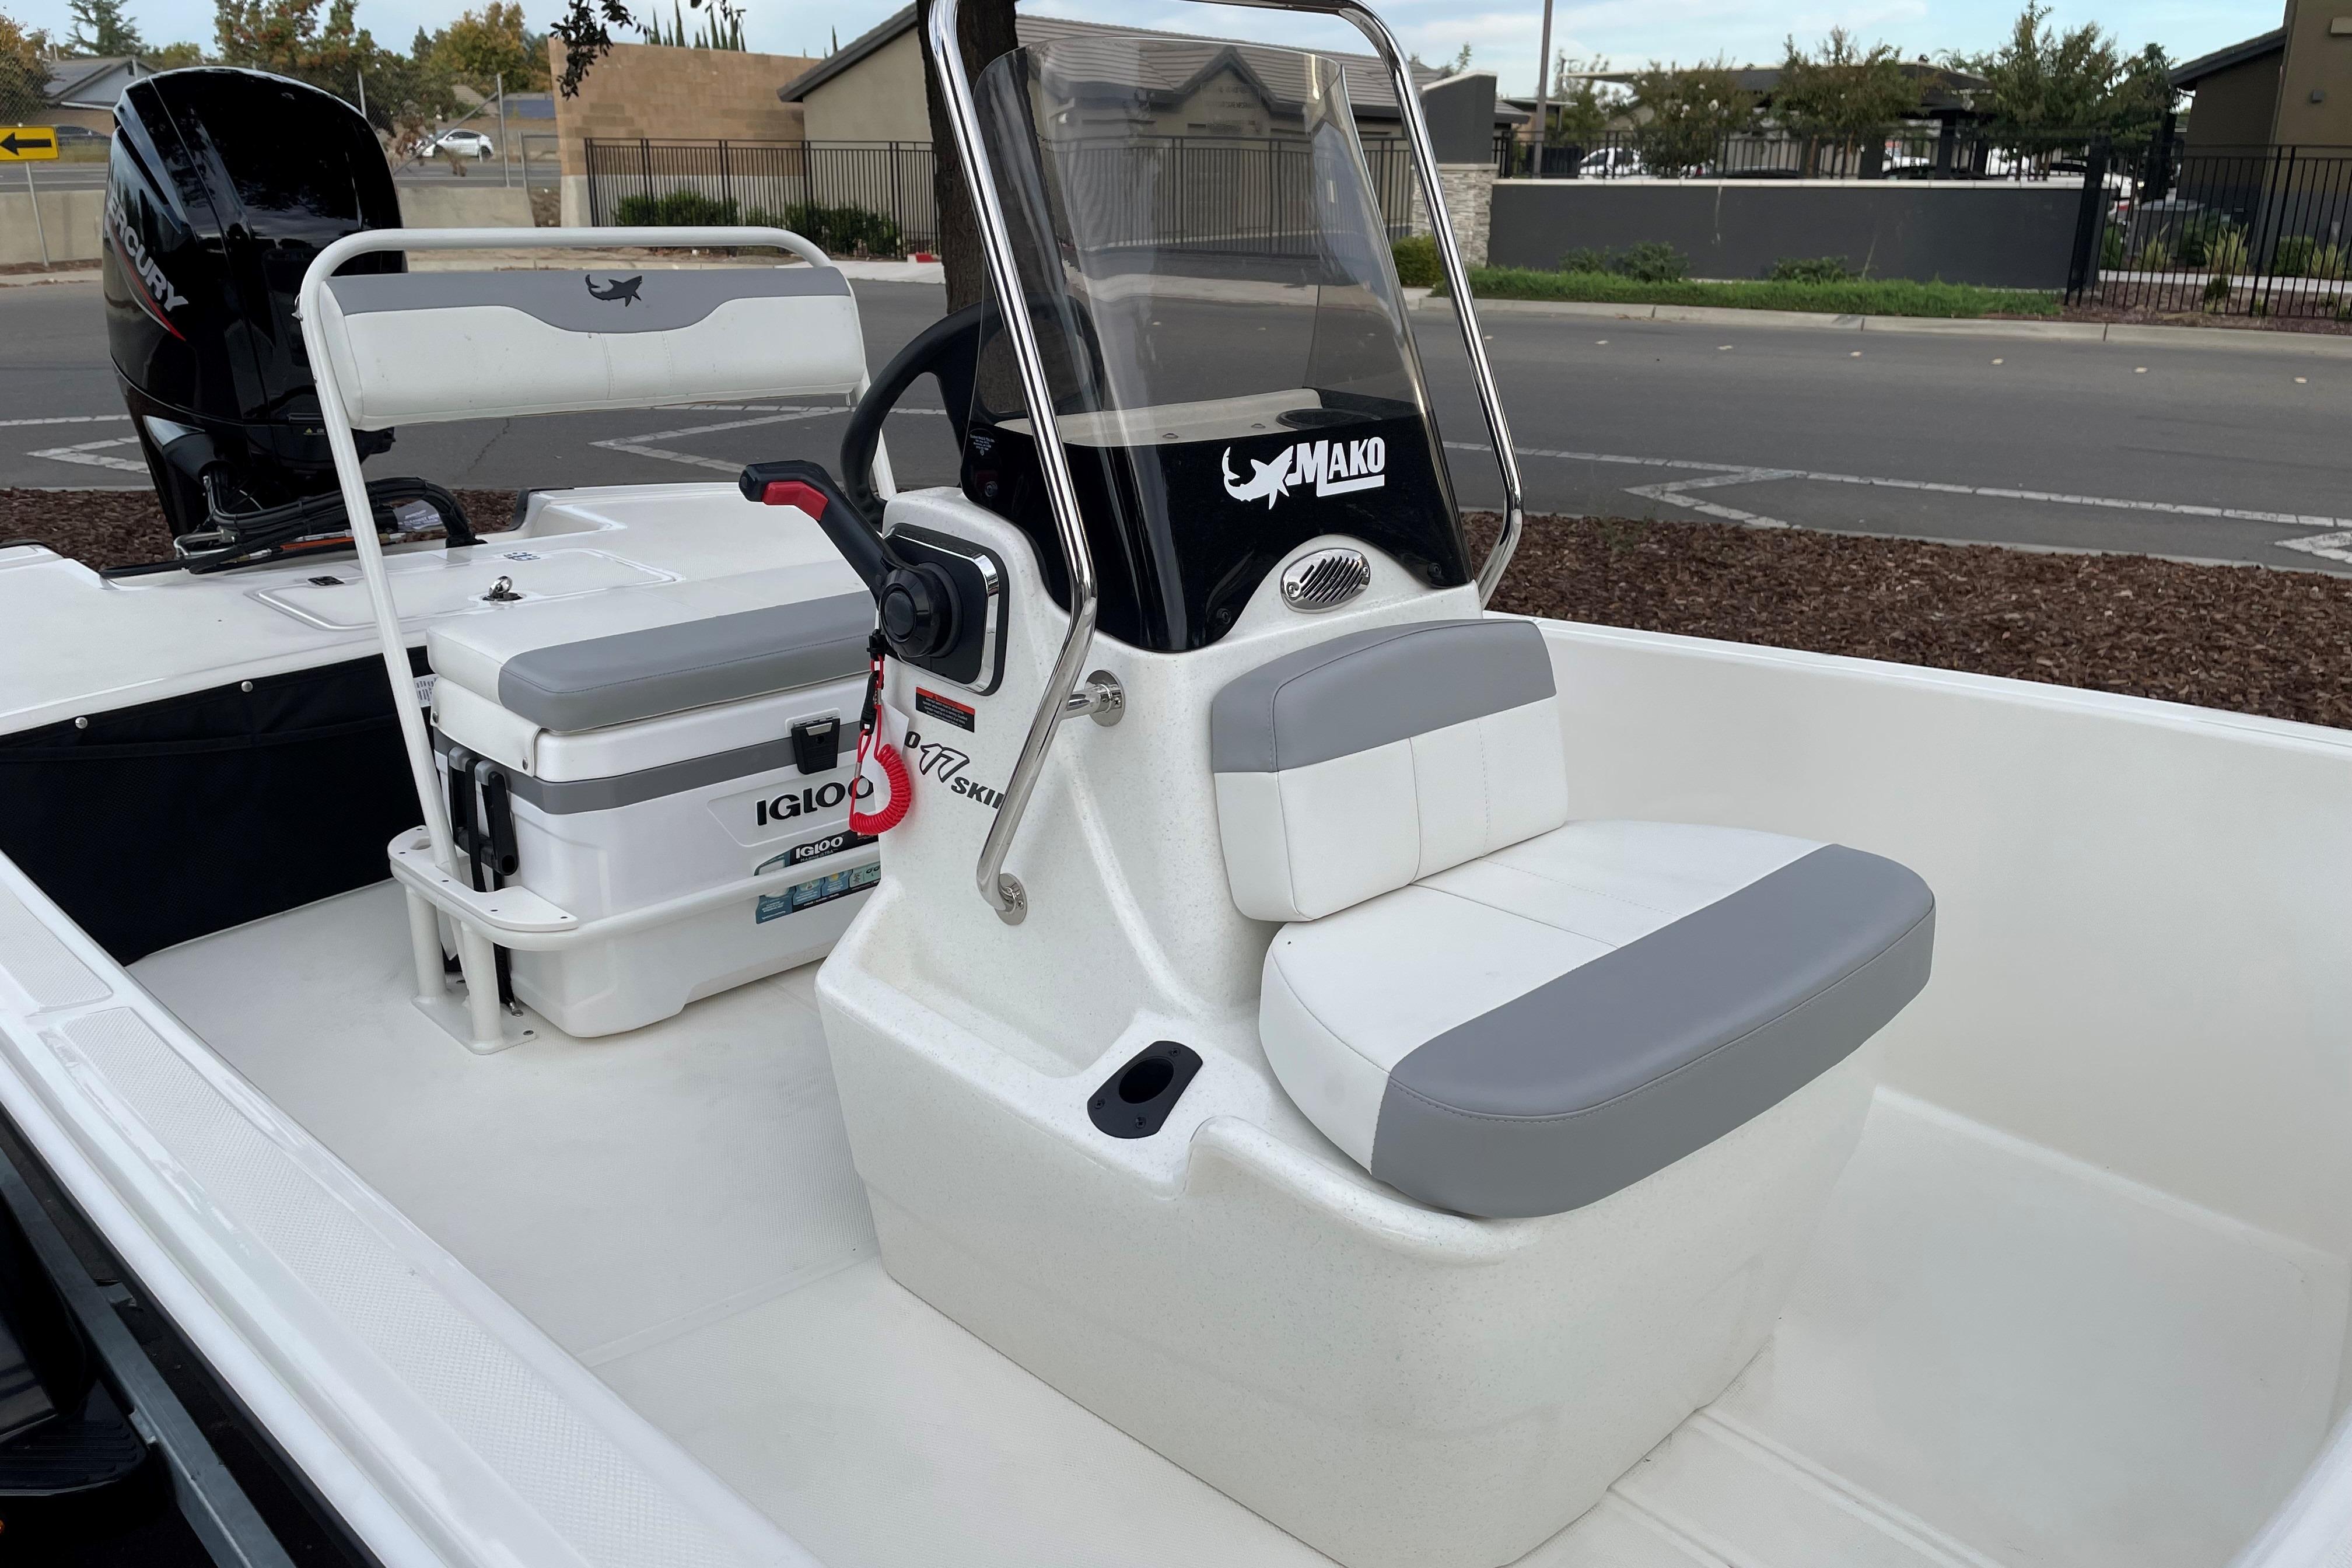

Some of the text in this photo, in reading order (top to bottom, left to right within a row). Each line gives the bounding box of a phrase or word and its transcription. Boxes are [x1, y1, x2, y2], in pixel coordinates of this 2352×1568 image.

[107, 190, 188, 312] ERCURY
[1284, 436, 1385, 497] MAKO
[919, 743, 971, 783] 17
[757, 775, 874, 826] IGLOO
[796, 836, 844, 859] IGLOO
